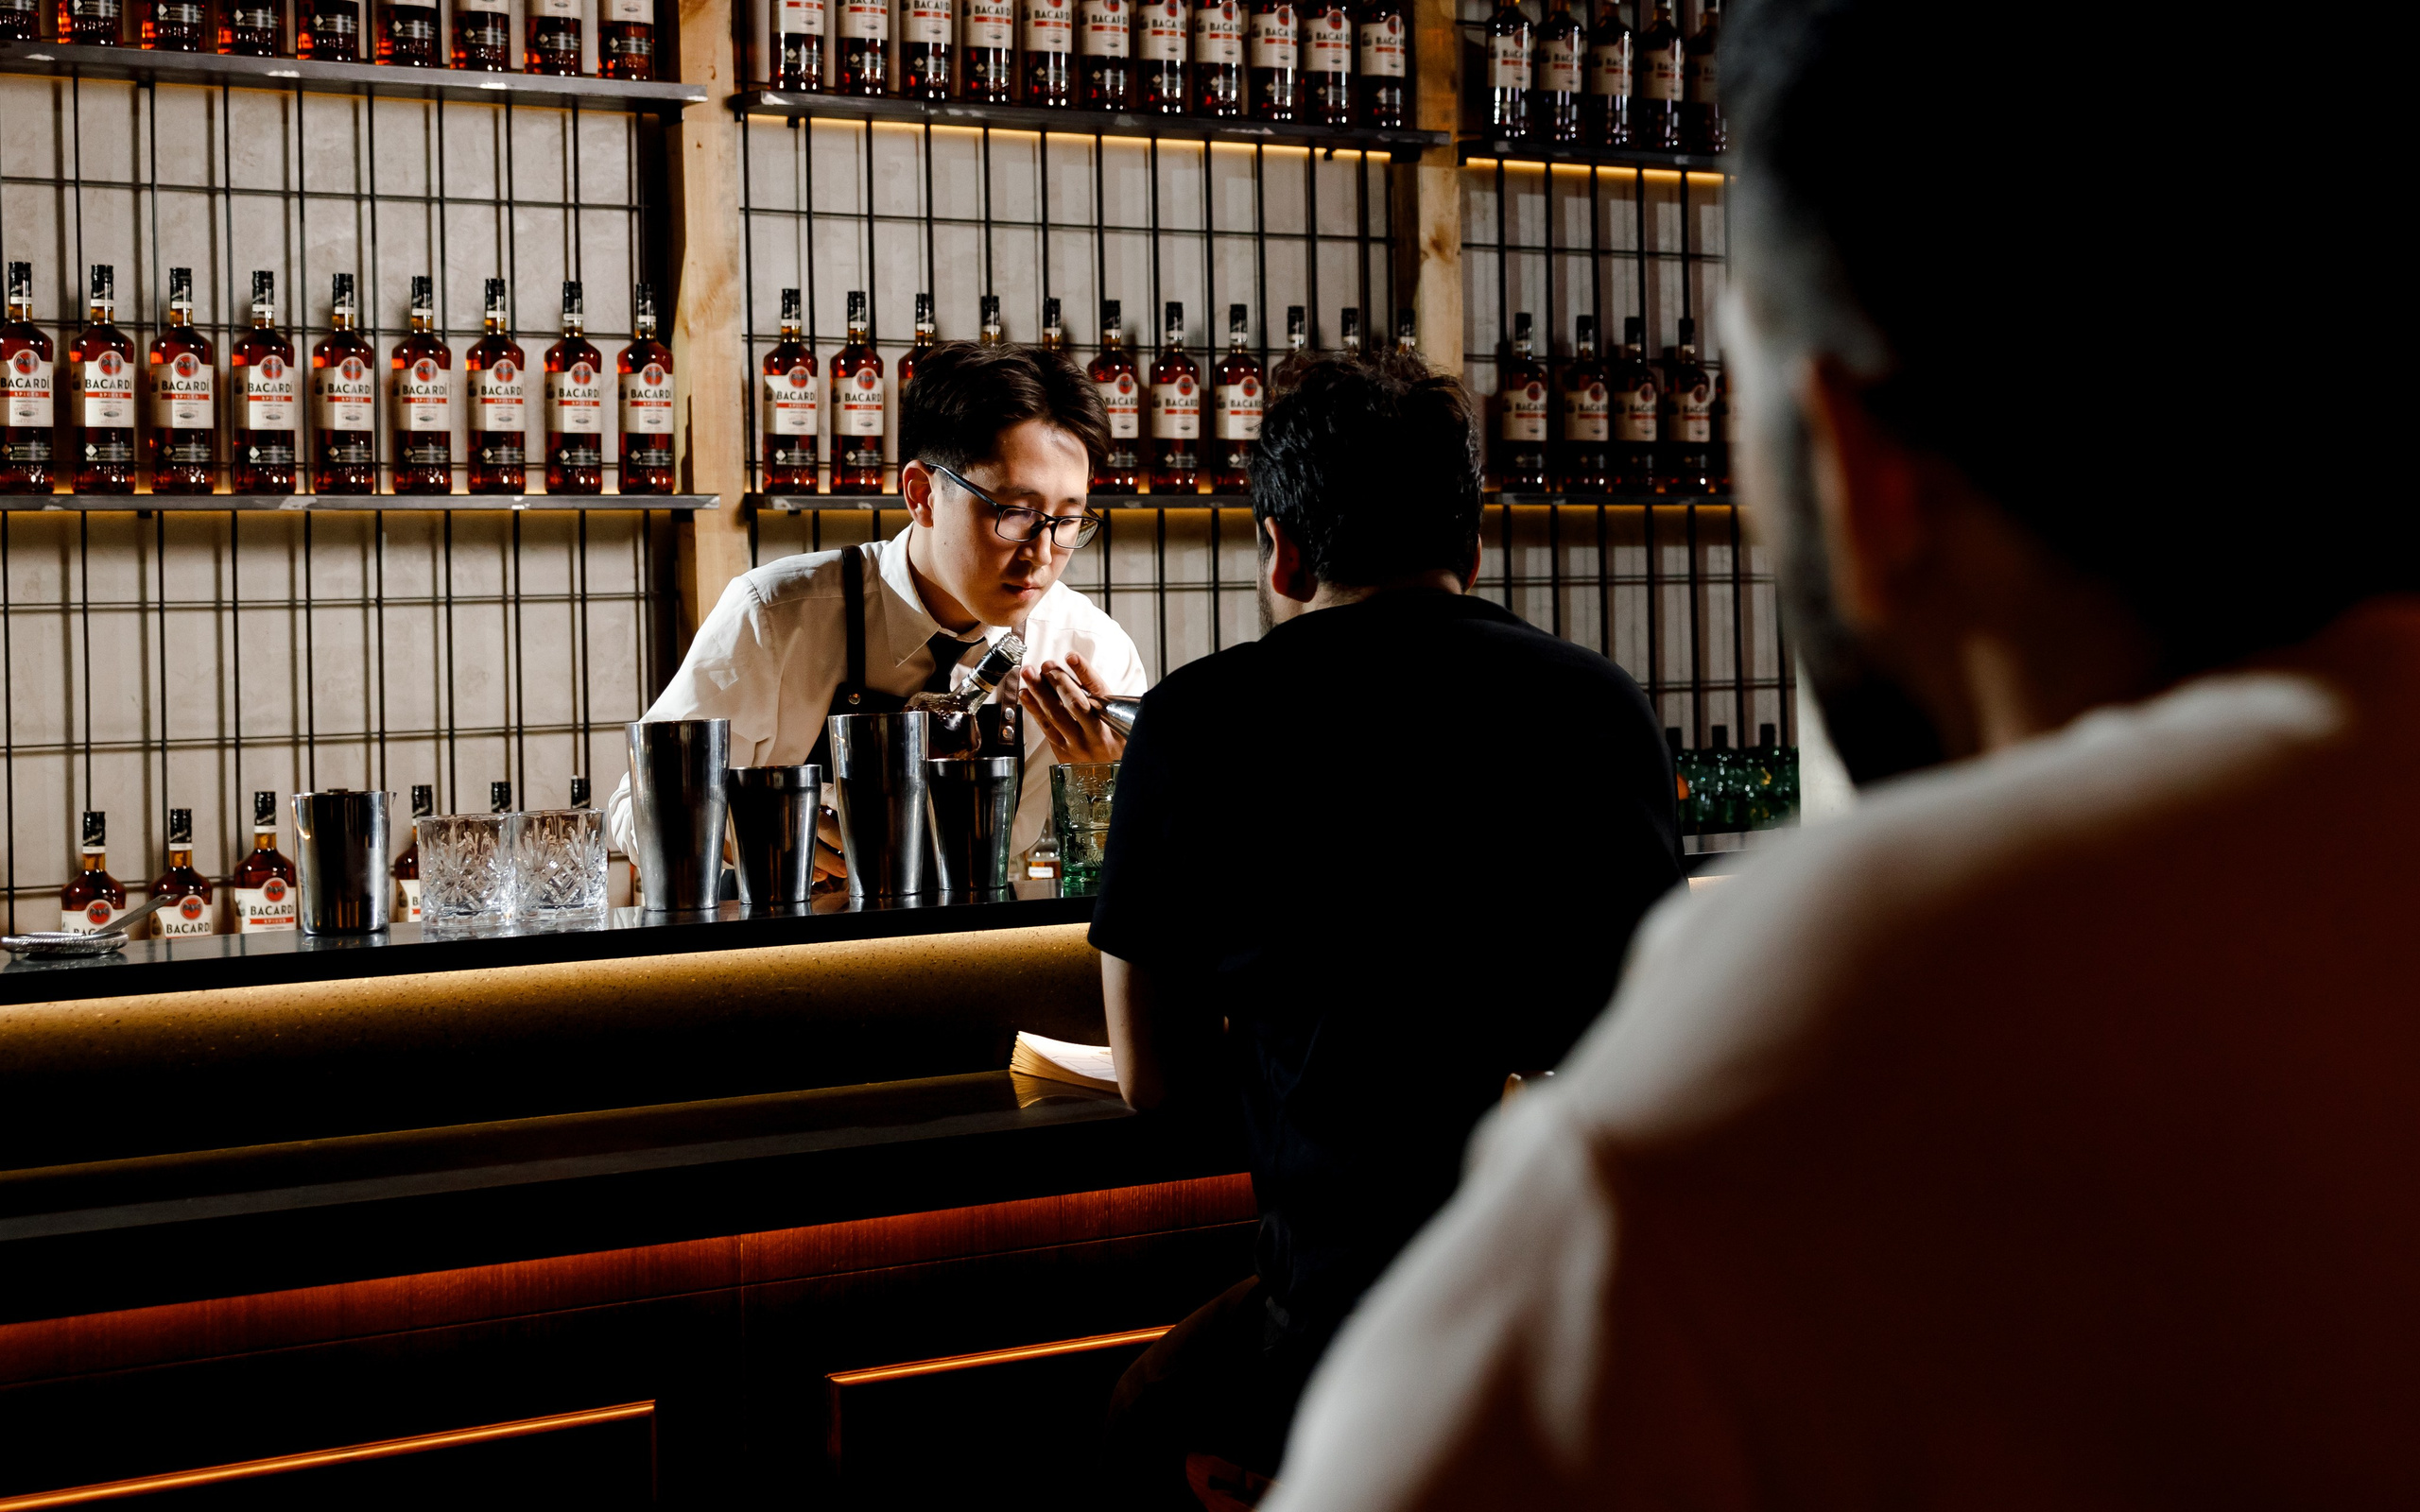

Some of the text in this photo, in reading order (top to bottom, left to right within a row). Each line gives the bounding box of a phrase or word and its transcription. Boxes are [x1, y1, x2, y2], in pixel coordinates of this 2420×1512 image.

[1, 376, 49, 388] BACARDÍ
[85, 379, 132, 389] BACARDÍ
[162, 379, 209, 391] BACARDÍ
